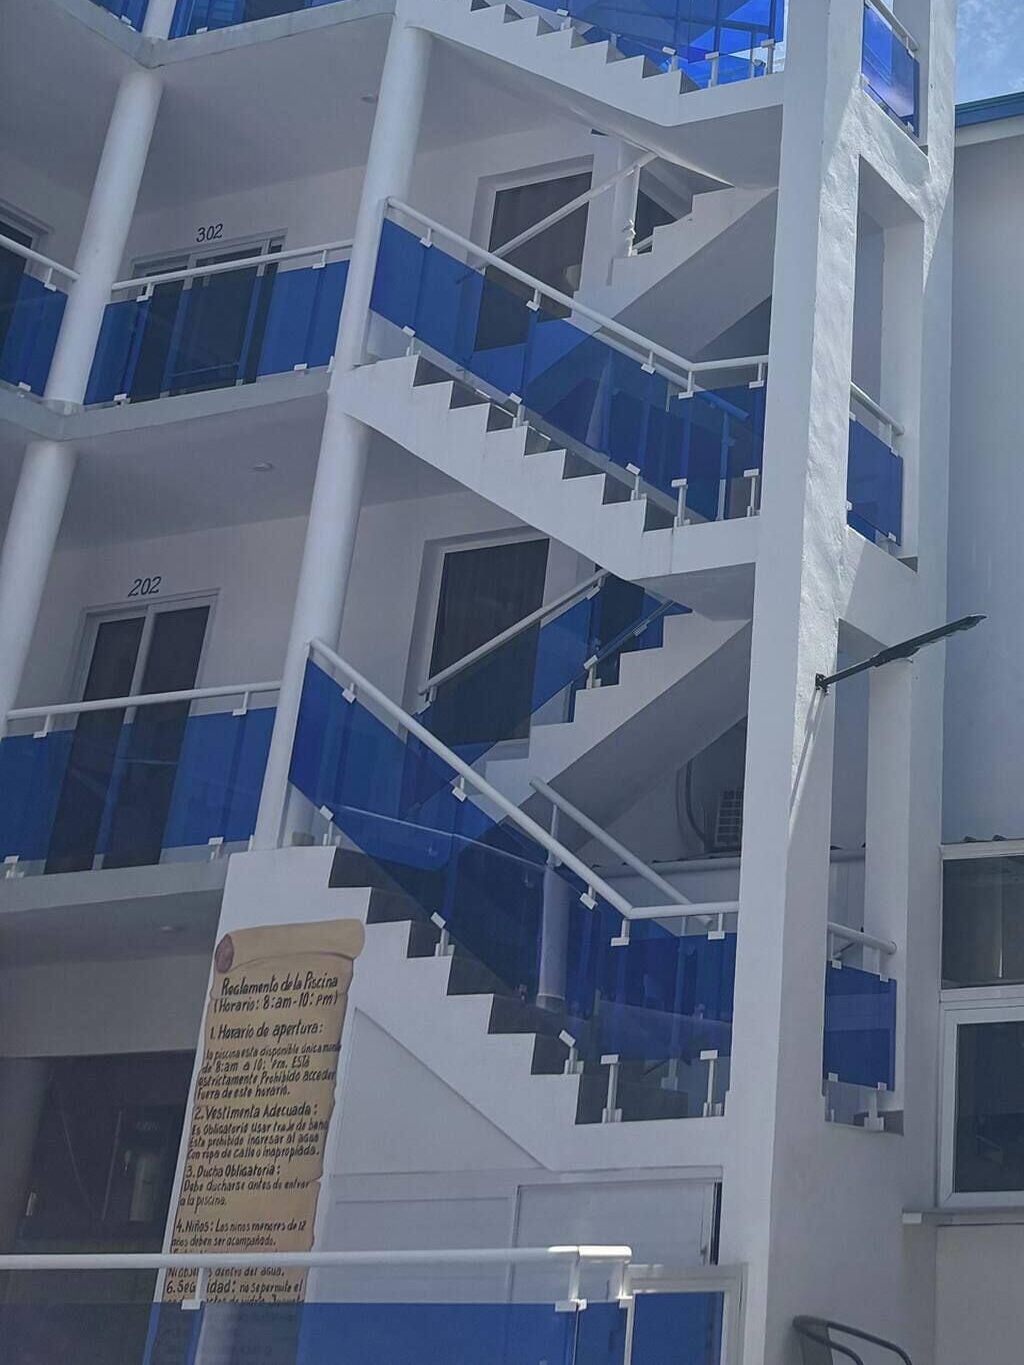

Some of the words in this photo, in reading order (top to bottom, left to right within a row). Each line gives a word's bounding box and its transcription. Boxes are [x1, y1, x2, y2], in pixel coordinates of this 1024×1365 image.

[196, 223, 224, 243] 302
[127, 576, 162, 597] 202
[220, 975, 279, 997] Reglamento
[303, 970, 339, 990] Piscina
[256, 1021, 270, 1038] de
[272, 1019, 323, 1044] apertura:
